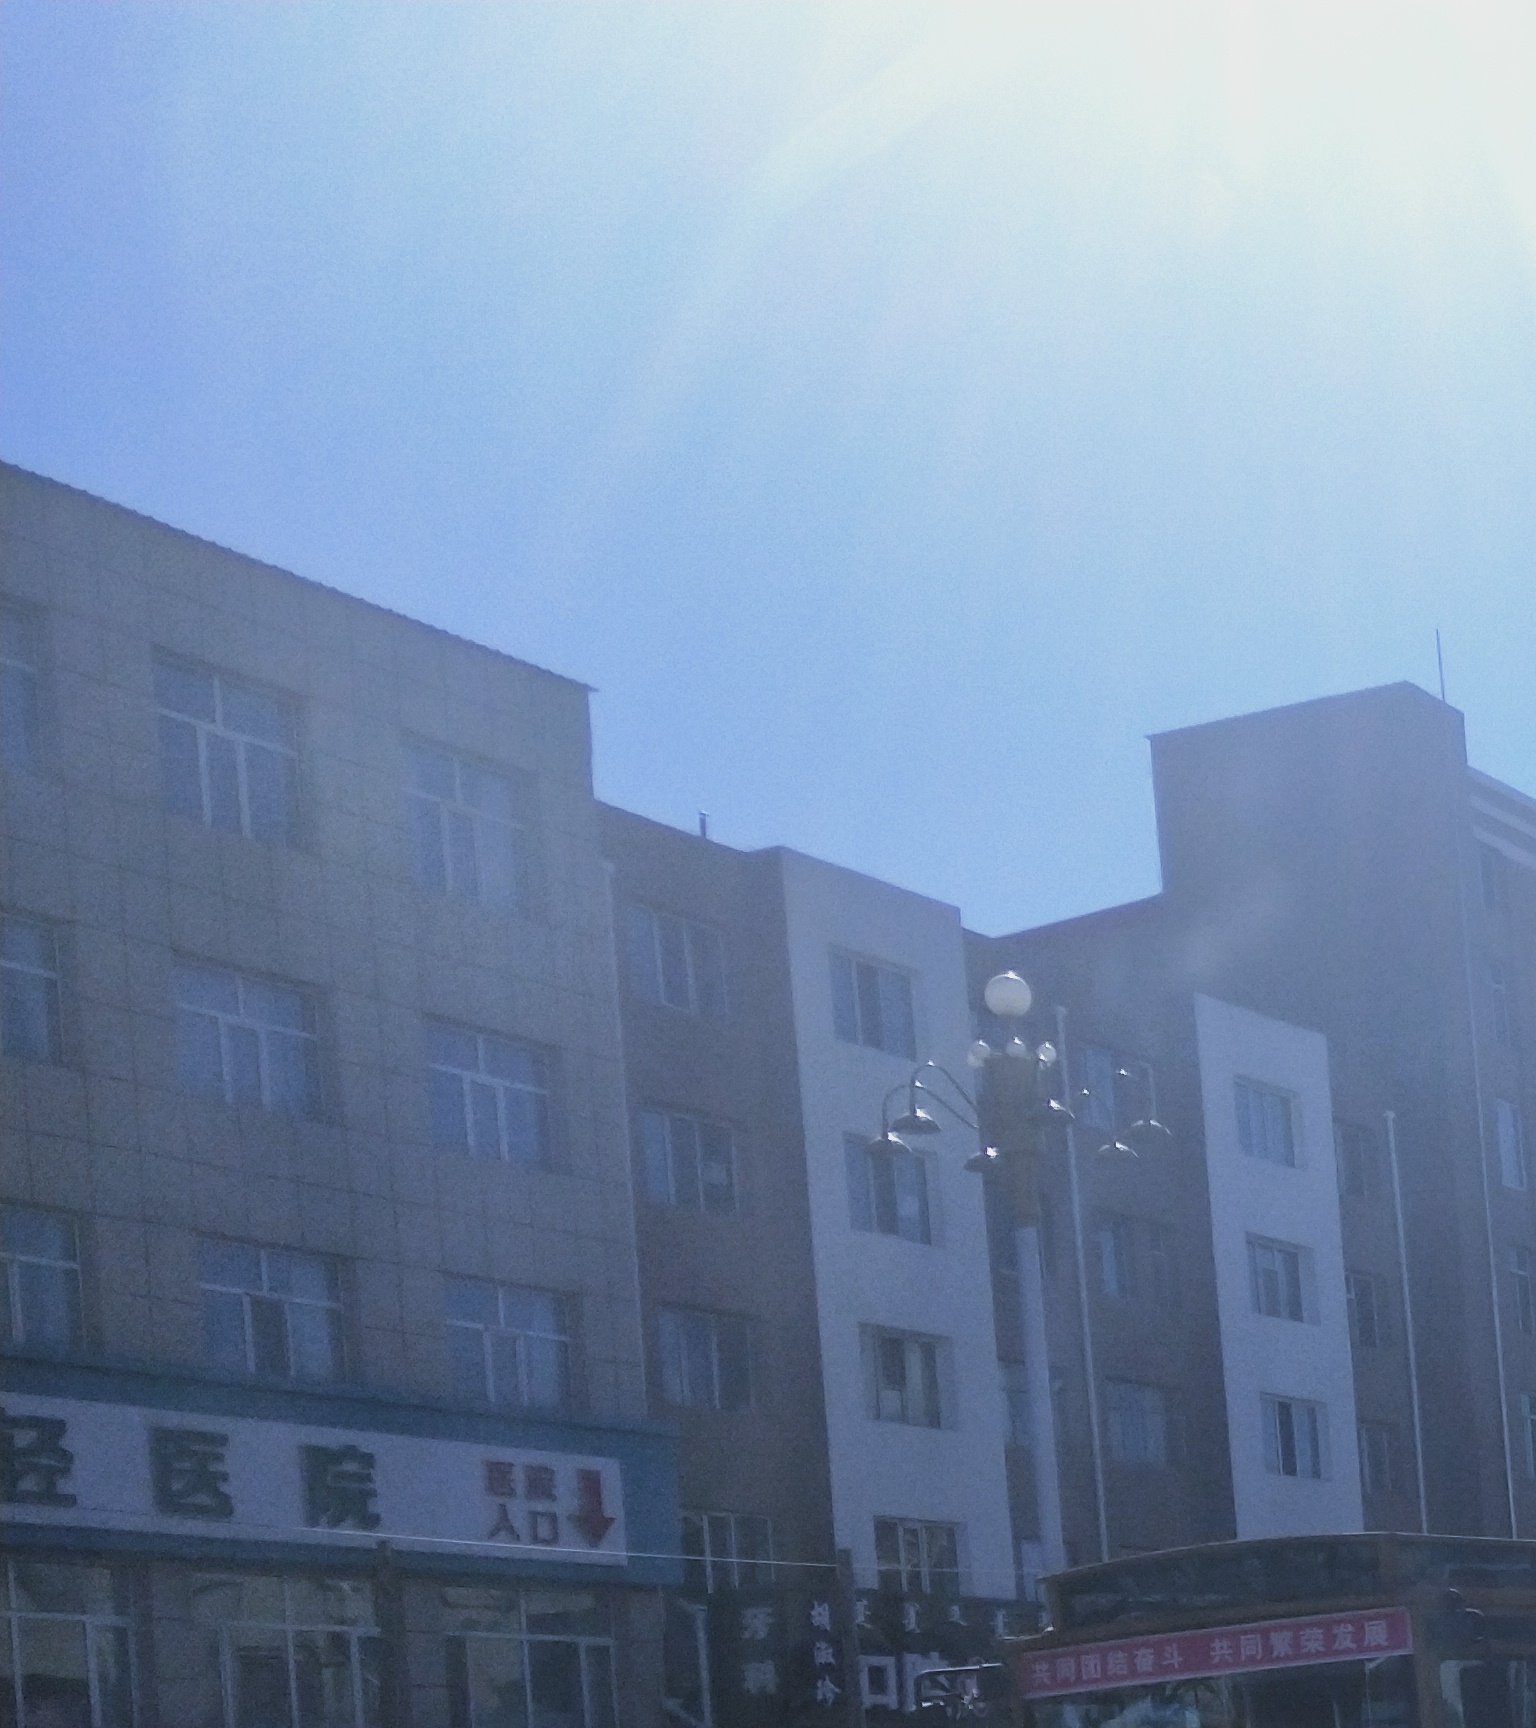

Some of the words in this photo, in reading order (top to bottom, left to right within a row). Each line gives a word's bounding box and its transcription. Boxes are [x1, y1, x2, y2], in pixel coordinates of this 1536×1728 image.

[484, 1459, 557, 1503] 医院
[488, 1505, 559, 1545] 入口
[1030, 1644, 1184, 1687] 共同团结奋斗
[1209, 1620, 1390, 1666] 共同繁荣发展
